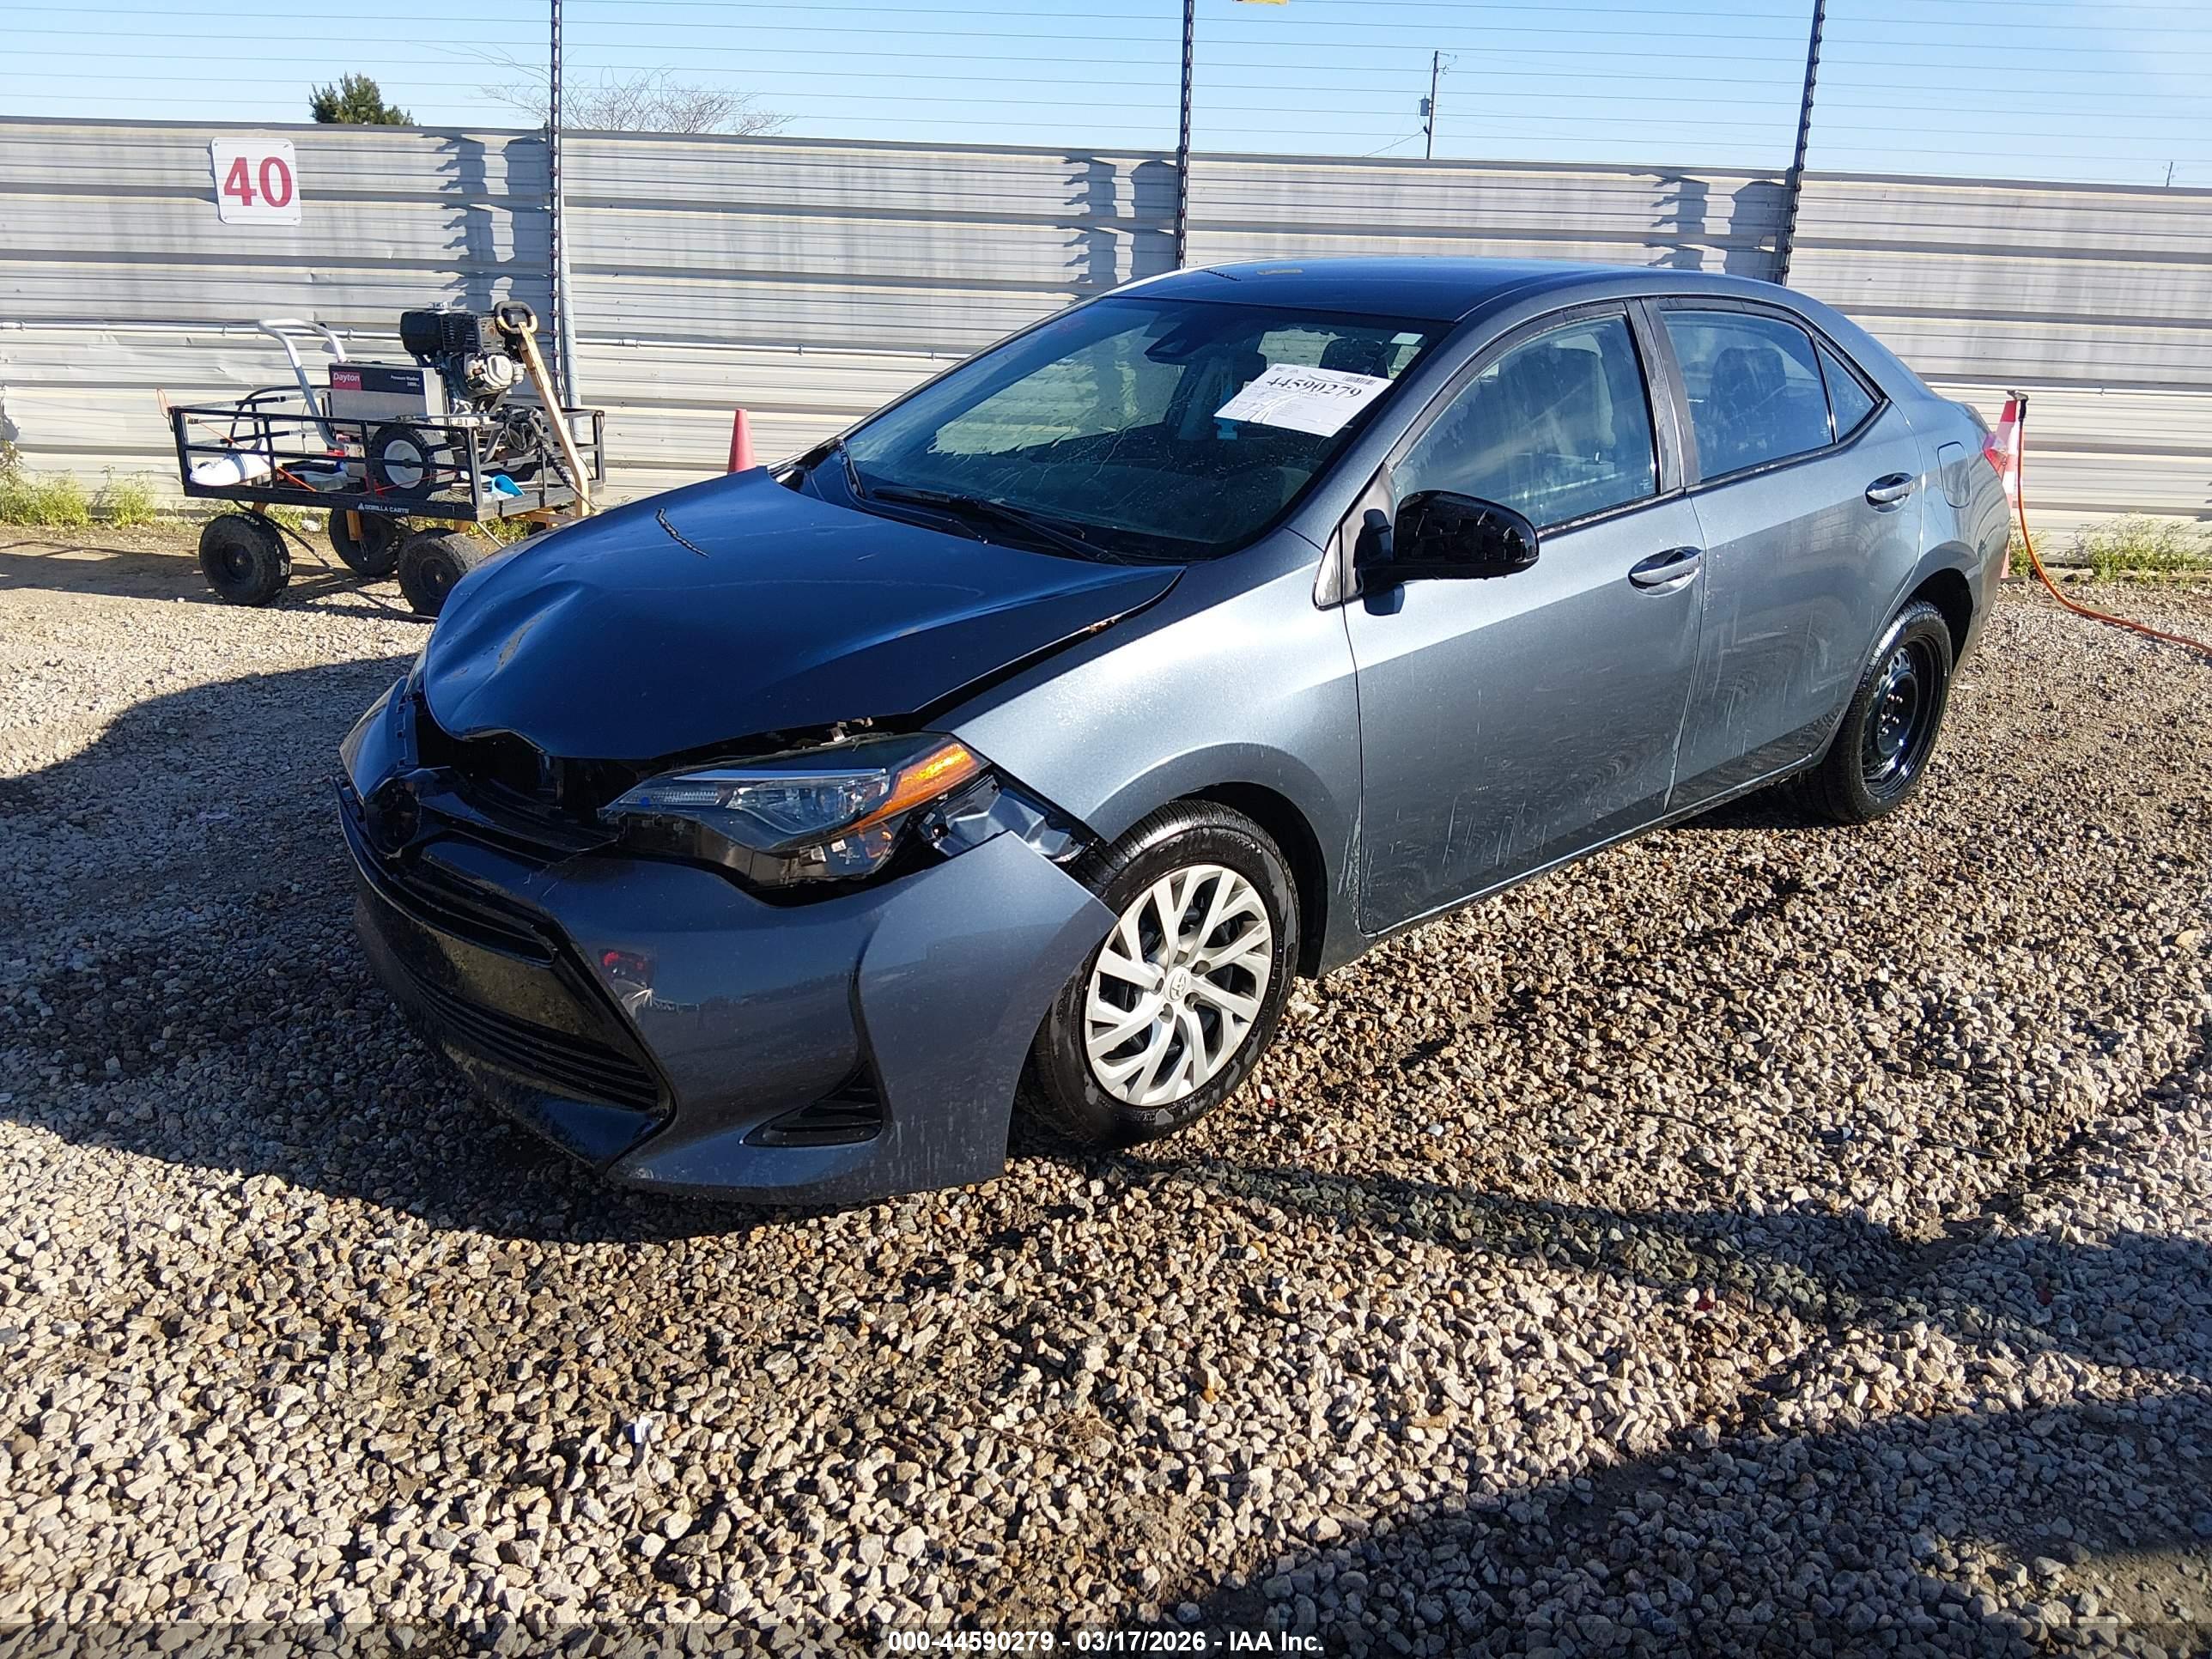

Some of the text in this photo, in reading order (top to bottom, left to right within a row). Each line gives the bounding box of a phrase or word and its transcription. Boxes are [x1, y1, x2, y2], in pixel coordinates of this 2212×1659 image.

[224, 157, 292, 207] 40
[332, 373, 360, 383] Dayton
[1267, 376, 1363, 399] 44590279
